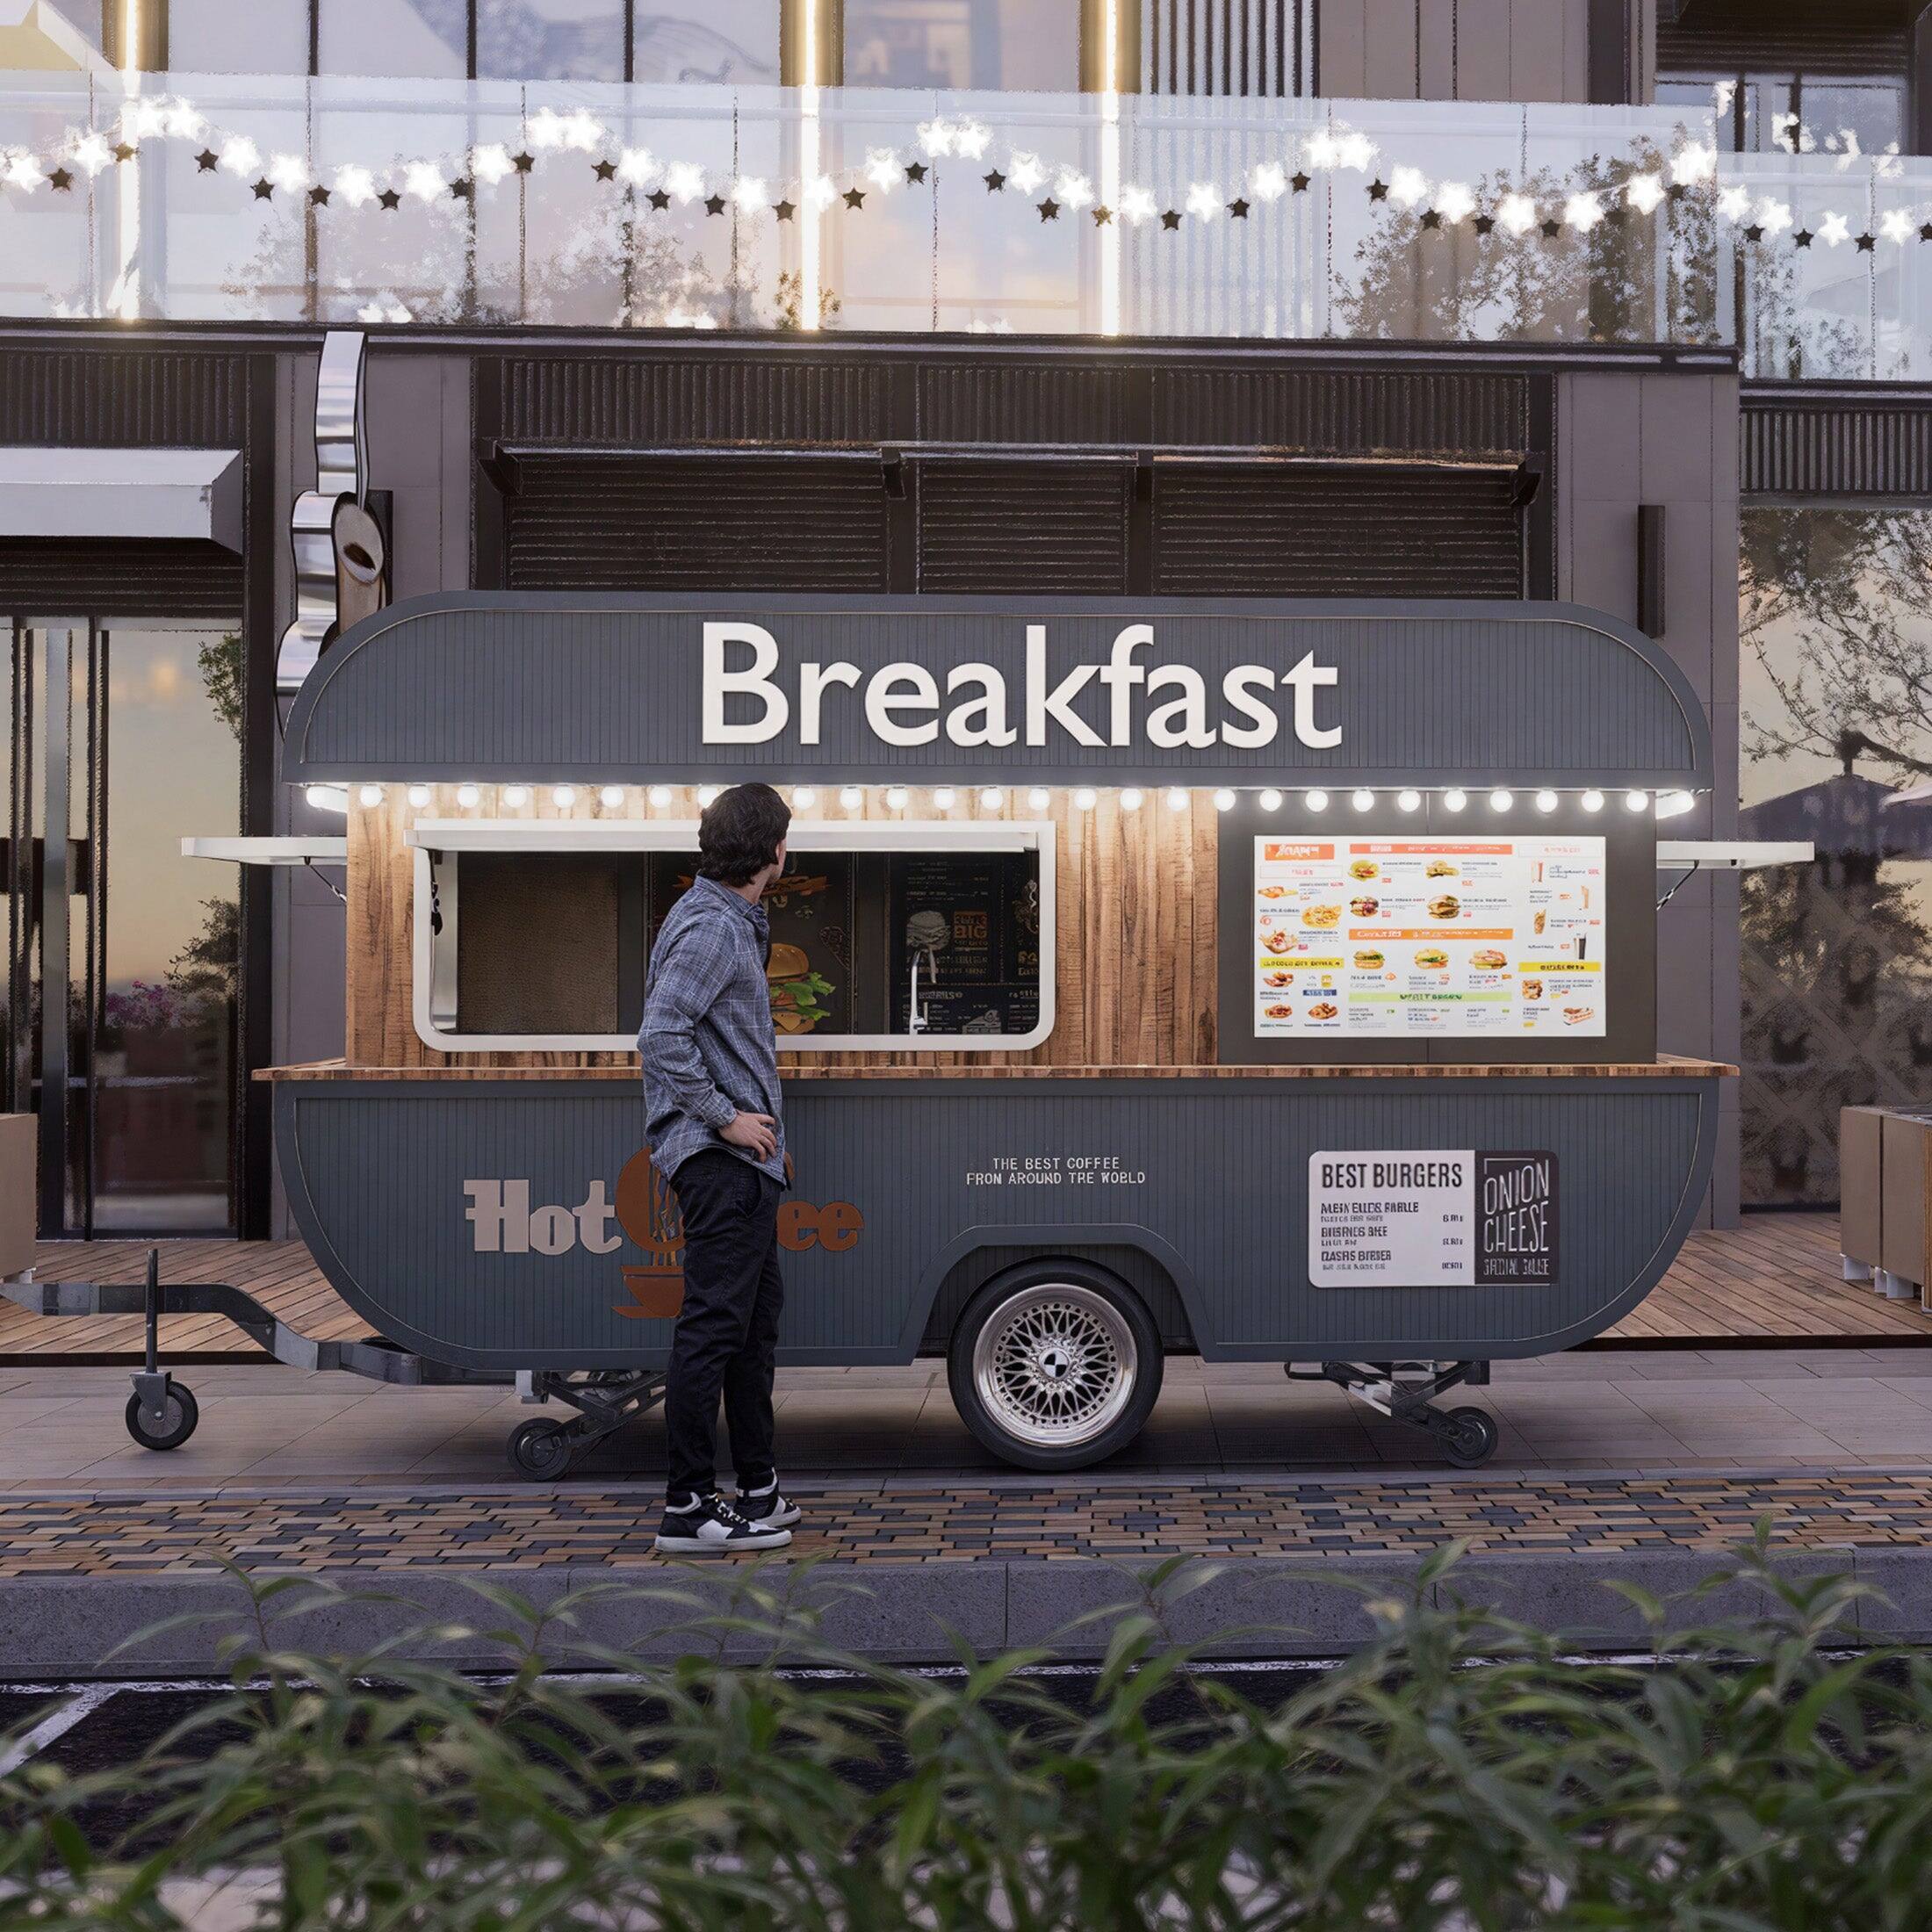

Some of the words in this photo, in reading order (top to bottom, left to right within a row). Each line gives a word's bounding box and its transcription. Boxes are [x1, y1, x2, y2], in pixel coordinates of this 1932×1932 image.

[703, 622, 1342, 748] Breakfast
[993, 1157, 1018, 1170] THE
[1025, 1157, 1061, 1170] BEST
[1067, 1157, 1120, 1169] COFFEE
[1008, 1172, 1062, 1185] AROUND
[1322, 1163, 1367, 1188] BEST
[1373, 1163, 1462, 1188] BURGERS
[1484, 1158, 1549, 1215] ONION
[464, 1179, 623, 1255] Hot
[1484, 1200, 1549, 1253] CHEESE
